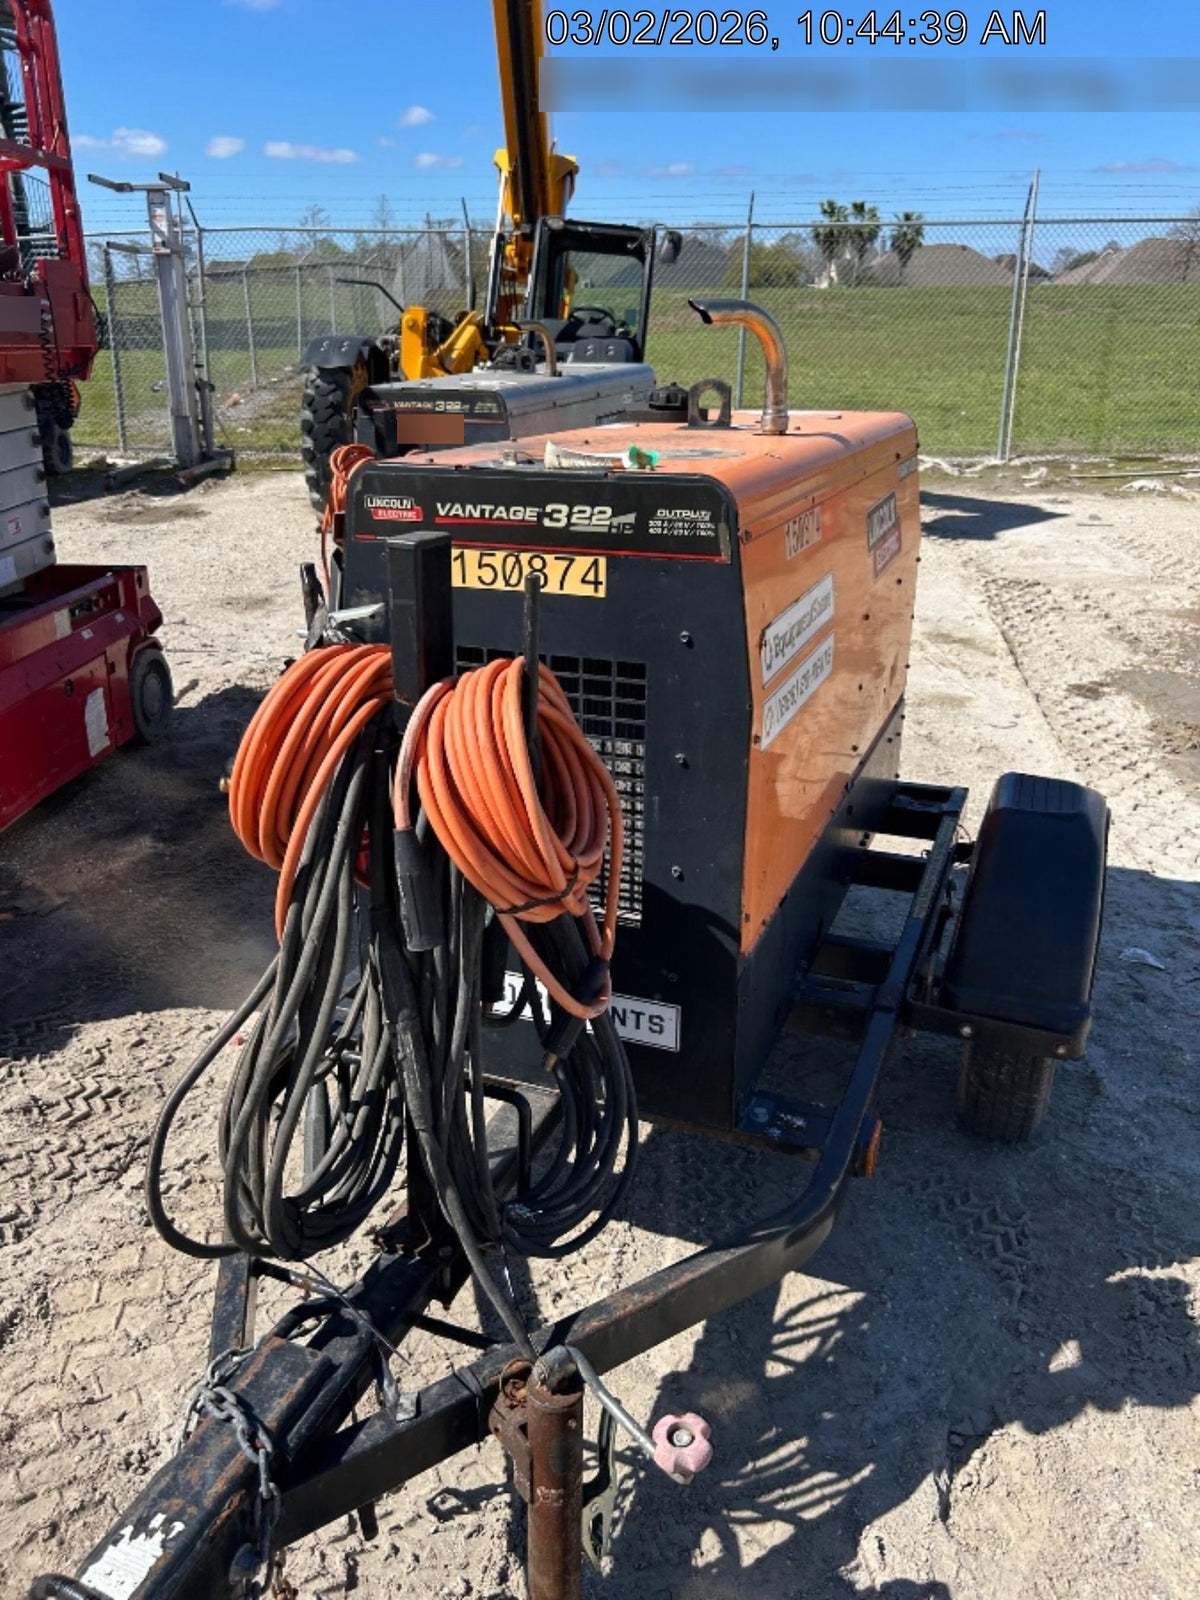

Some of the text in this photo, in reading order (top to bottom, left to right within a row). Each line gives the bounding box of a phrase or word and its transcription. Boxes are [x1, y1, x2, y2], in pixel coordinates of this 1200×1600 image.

[366, 497, 412, 510] LINCOLN
[435, 502, 540, 522] VANTAGE
[542, 502, 613, 528] 322
[452, 549, 604, 594] 150874
